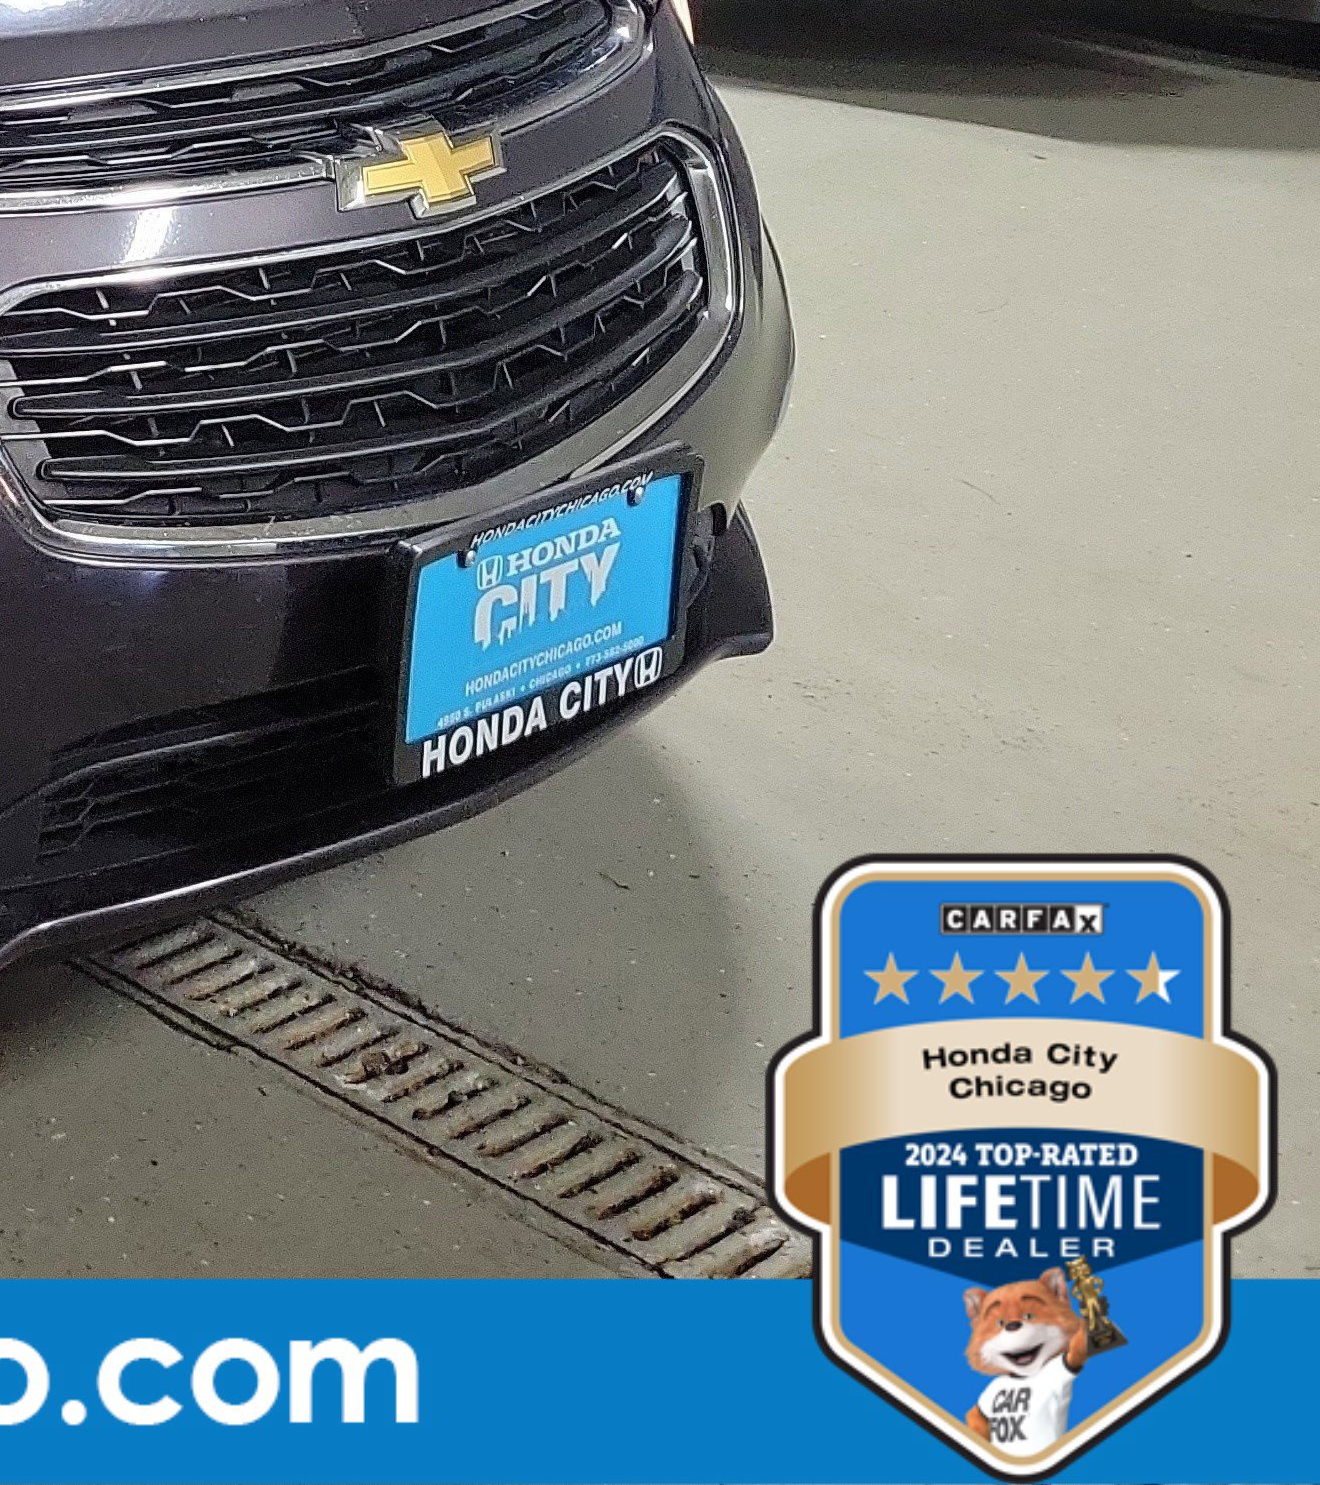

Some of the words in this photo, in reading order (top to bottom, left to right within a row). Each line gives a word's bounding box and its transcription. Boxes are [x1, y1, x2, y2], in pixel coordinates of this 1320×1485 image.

[470, 471, 654, 549] HONDACITYCHICAGO.COM
[506, 517, 622, 577] HONDA
[472, 542, 621, 651] CITY
[465, 621, 623, 697] HONDACITYCHICAGO.COM
[528, 664, 572, 690] CHICAGO
[421, 695, 548, 779] HONDA
[559, 657, 635, 720] CITY
